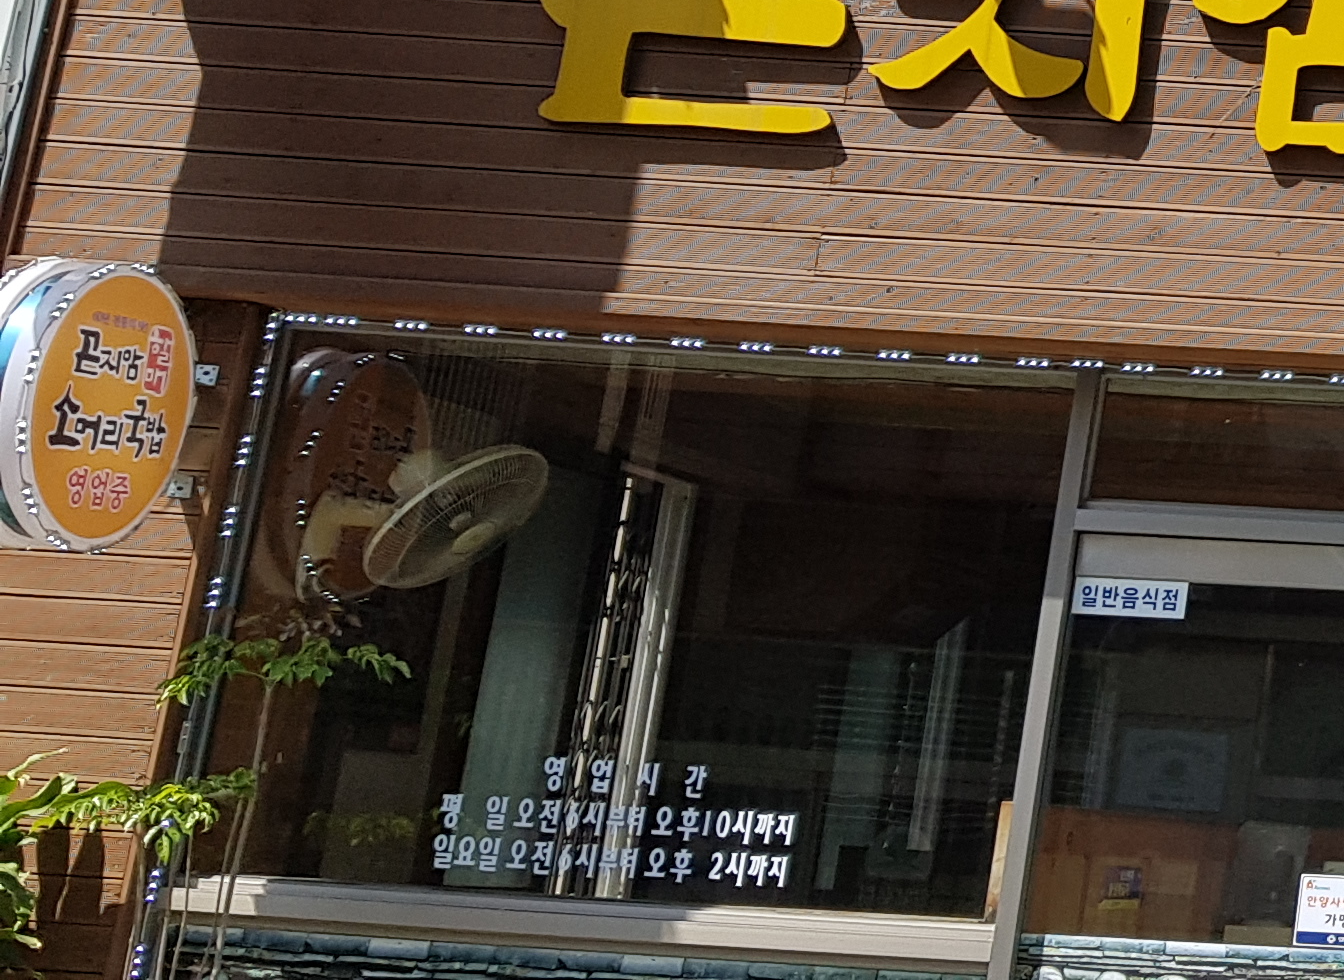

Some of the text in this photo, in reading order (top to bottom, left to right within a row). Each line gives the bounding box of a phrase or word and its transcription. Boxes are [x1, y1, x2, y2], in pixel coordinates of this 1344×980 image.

[74, 327, 173, 394] 곤지암 할매
[48, 384, 166, 458] 소머리국밥
[69, 469, 128, 510] 영업중
[1080, 584, 1179, 612] 일반음식점
[433, 833, 501, 872] 일요일
